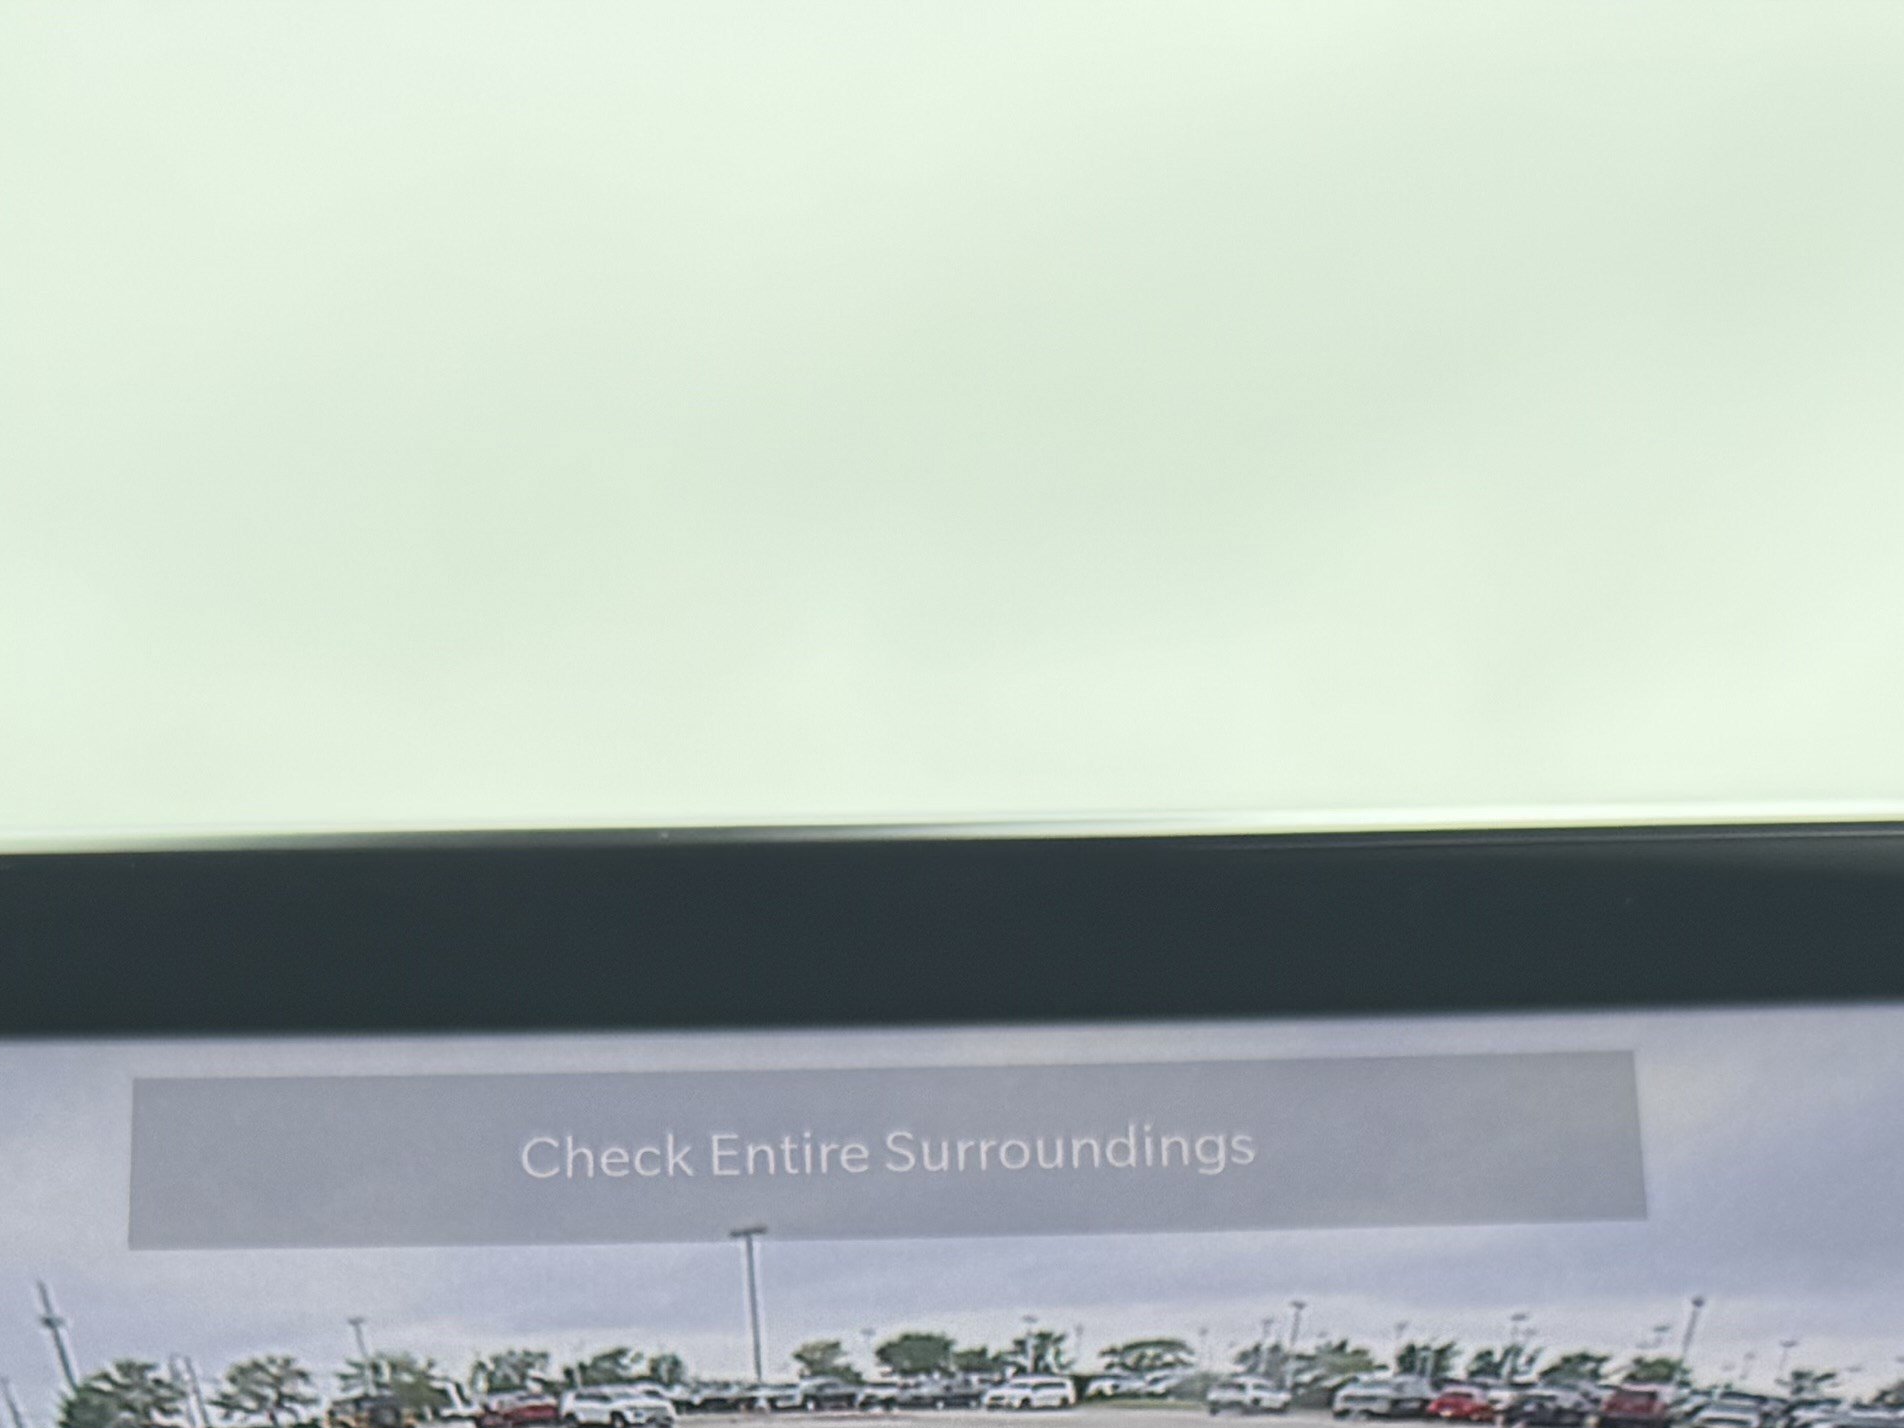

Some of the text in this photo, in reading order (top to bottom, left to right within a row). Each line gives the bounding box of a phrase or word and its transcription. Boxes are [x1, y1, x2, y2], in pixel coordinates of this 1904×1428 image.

[519, 1122, 1258, 1180] Check Entire Surroundings
